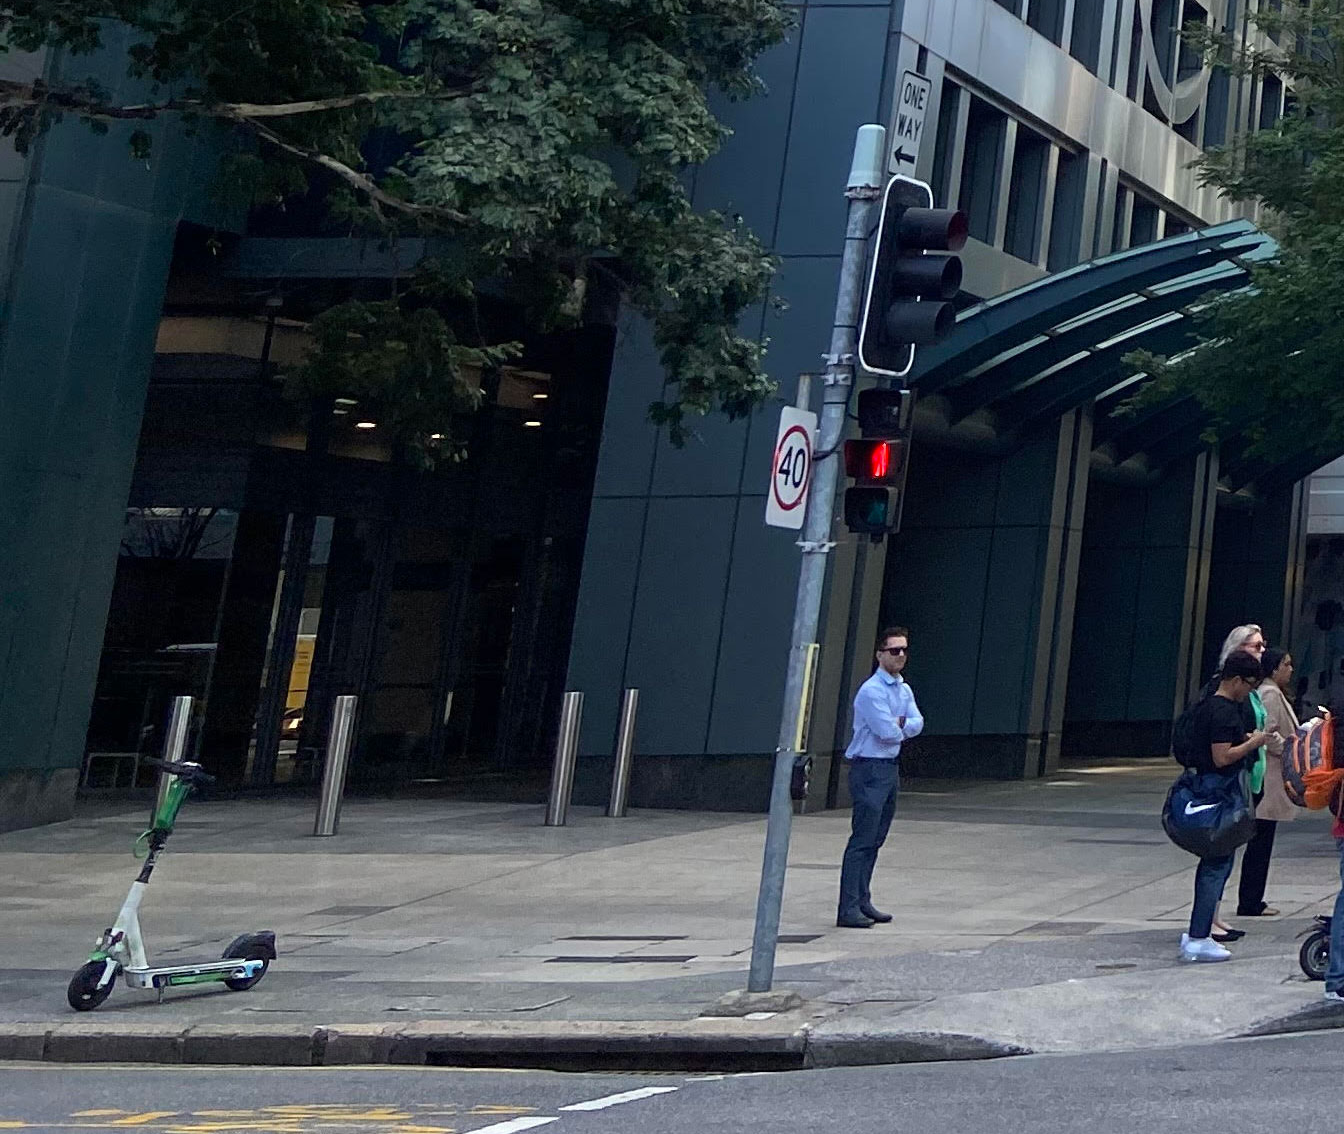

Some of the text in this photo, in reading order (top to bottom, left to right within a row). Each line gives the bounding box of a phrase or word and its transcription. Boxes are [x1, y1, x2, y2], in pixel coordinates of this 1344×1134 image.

[903, 82, 926, 110] ONE
[897, 112, 922, 142] WAY
[778, 446, 806, 489] 40
